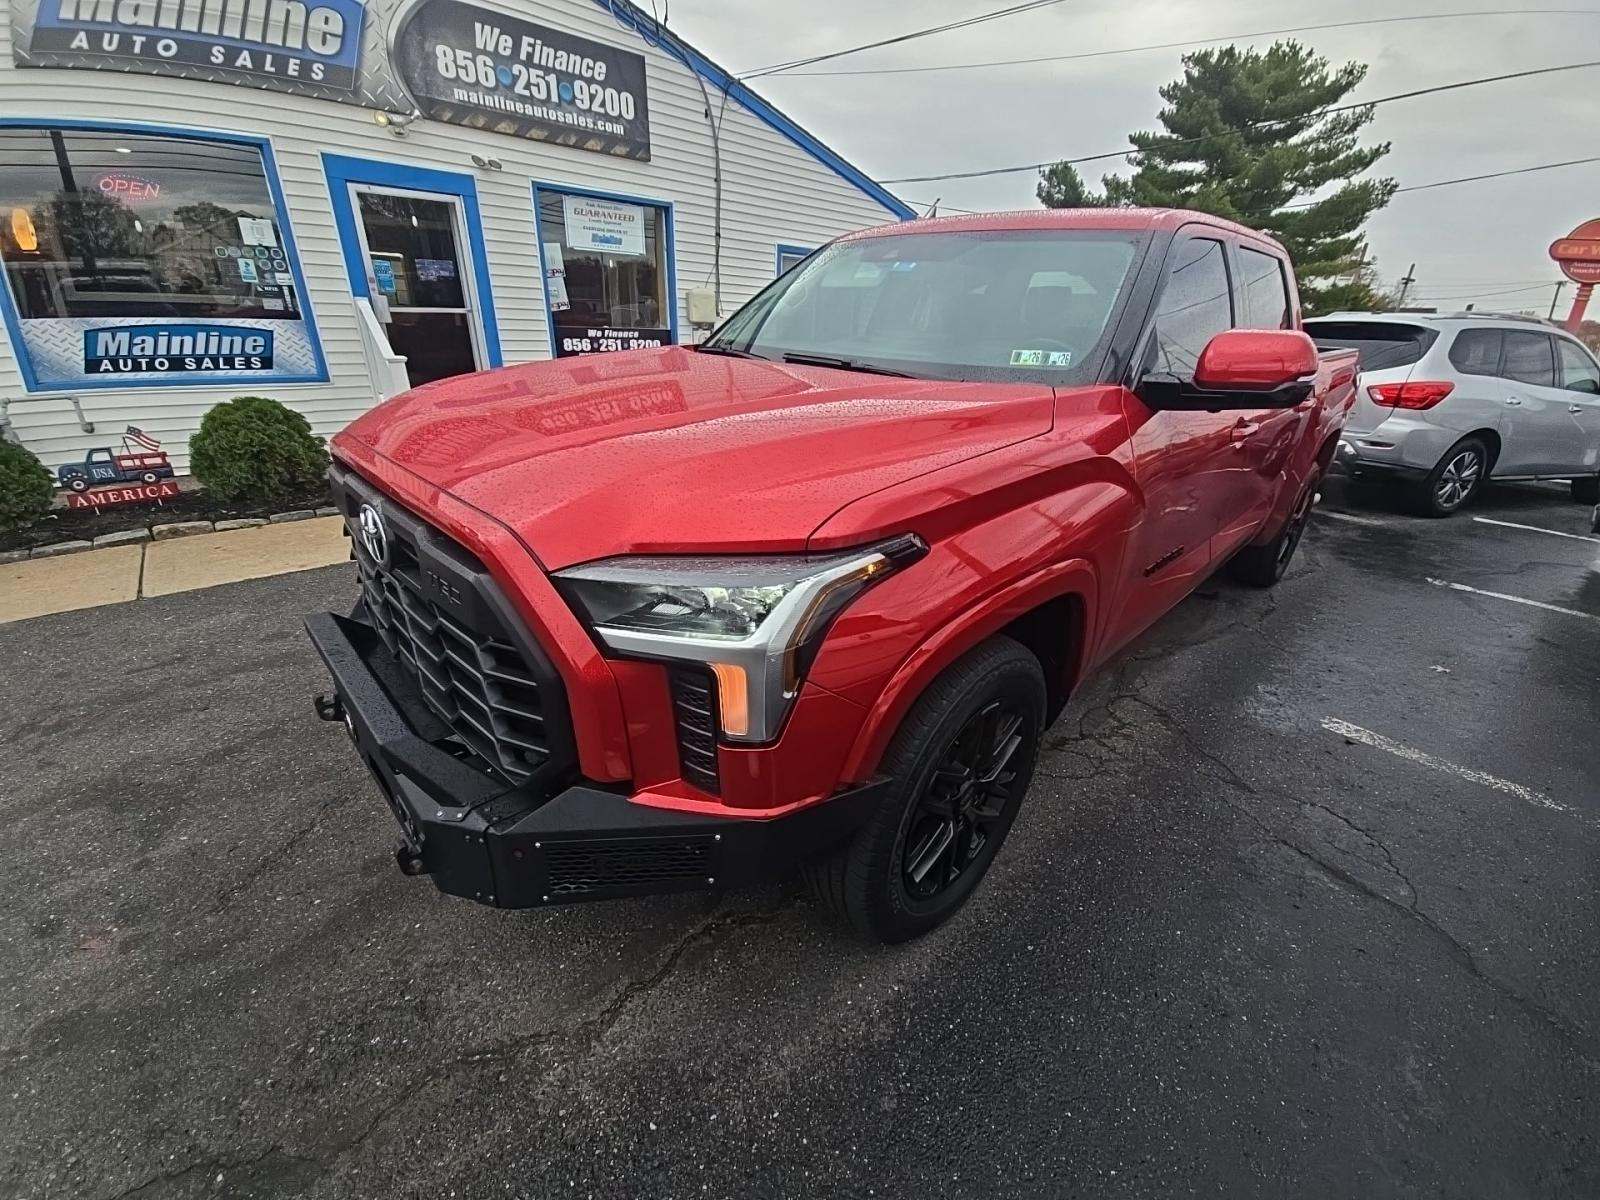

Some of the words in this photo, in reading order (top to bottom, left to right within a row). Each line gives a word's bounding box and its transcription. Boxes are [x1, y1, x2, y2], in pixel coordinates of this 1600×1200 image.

[71, 31, 178, 57] AUTO
[210, 45, 325, 80] SALES
[474, 21, 513, 56] We
[519, 35, 607, 81] Finance
[435, 44, 497, 88] 856
[512, 63, 559, 103] 251
[574, 79, 635, 120] 9200
[453, 87, 625, 136] mainlineautosales.com
[100, 178, 160, 198] OPEN
[573, 207, 635, 222] GUARANTEED
[587, 329, 602, 338] We
[604, 329, 639, 338] Finance
[96, 331, 266, 358] Mainline
[563, 338, 592, 352] 856
[599, 338, 622, 352] 251
[100, 358, 170, 371] AUTO
[184, 357, 262, 370] SALES
[92, 468, 116, 479] USA
[77, 484, 174, 507] AMERICA
